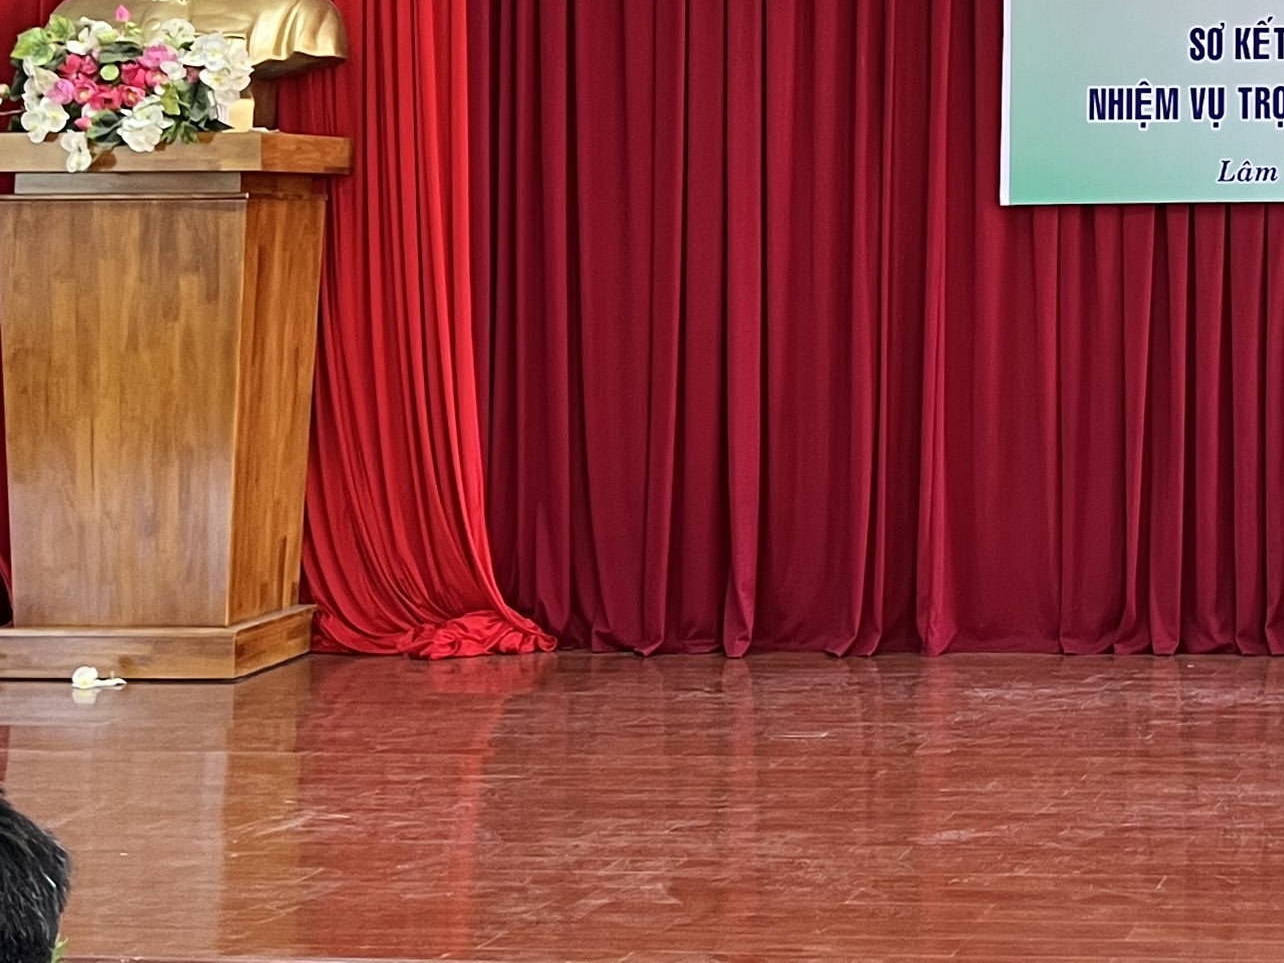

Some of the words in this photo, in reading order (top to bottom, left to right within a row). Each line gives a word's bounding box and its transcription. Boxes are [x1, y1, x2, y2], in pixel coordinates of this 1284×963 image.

[1189, 22, 1224, 60] SƠ
[1089, 80, 1178, 128] NHIỆM
[1190, 87, 1224, 127] VỤ
[1218, 160, 1276, 181] Lâm
